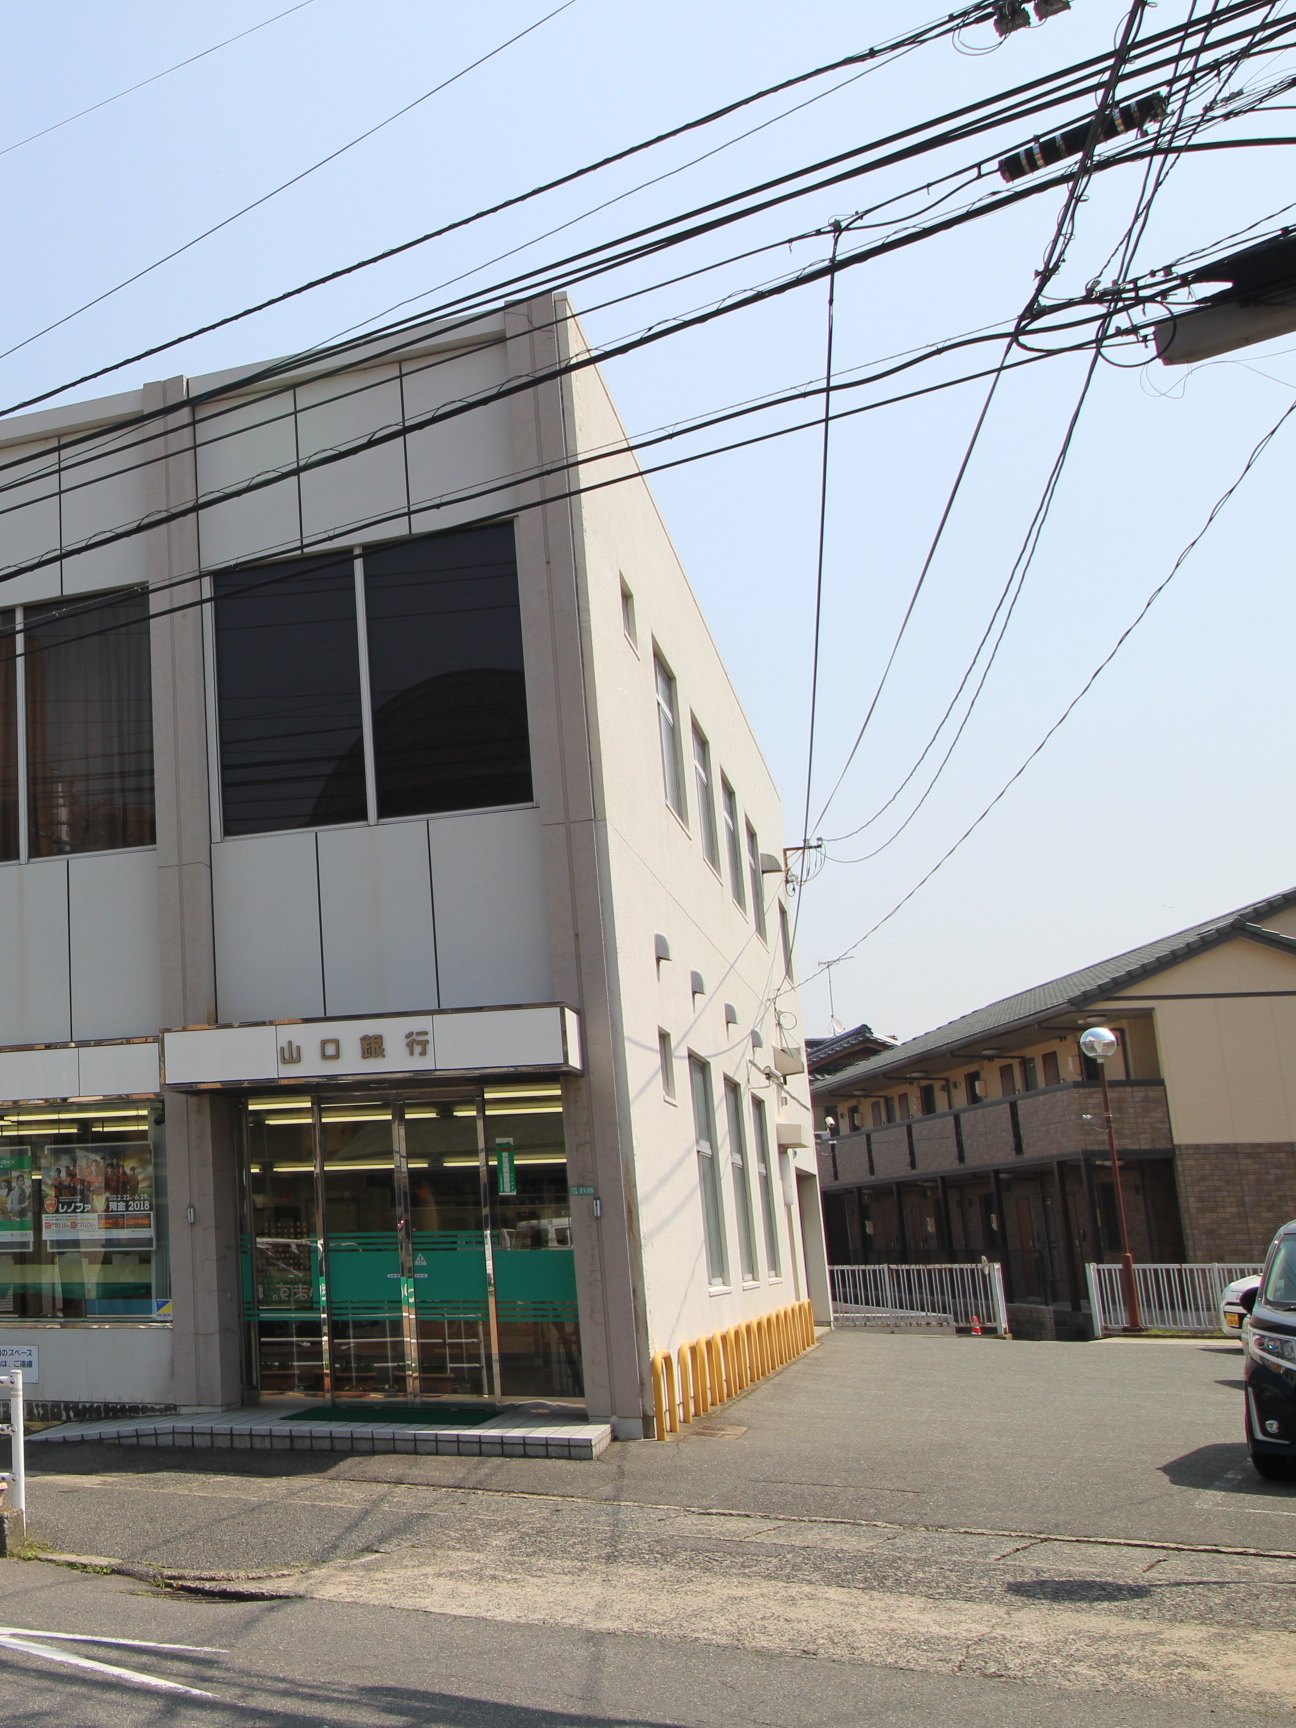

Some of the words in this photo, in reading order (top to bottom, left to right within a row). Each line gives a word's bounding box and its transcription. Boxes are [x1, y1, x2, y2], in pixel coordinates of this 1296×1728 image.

[279, 1031, 430, 1064] 山口銀行
[58, 1202, 92, 1213] レノファ
[108, 1201, 126, 1212] 預金
[128, 1200, 150, 1211] 2018
